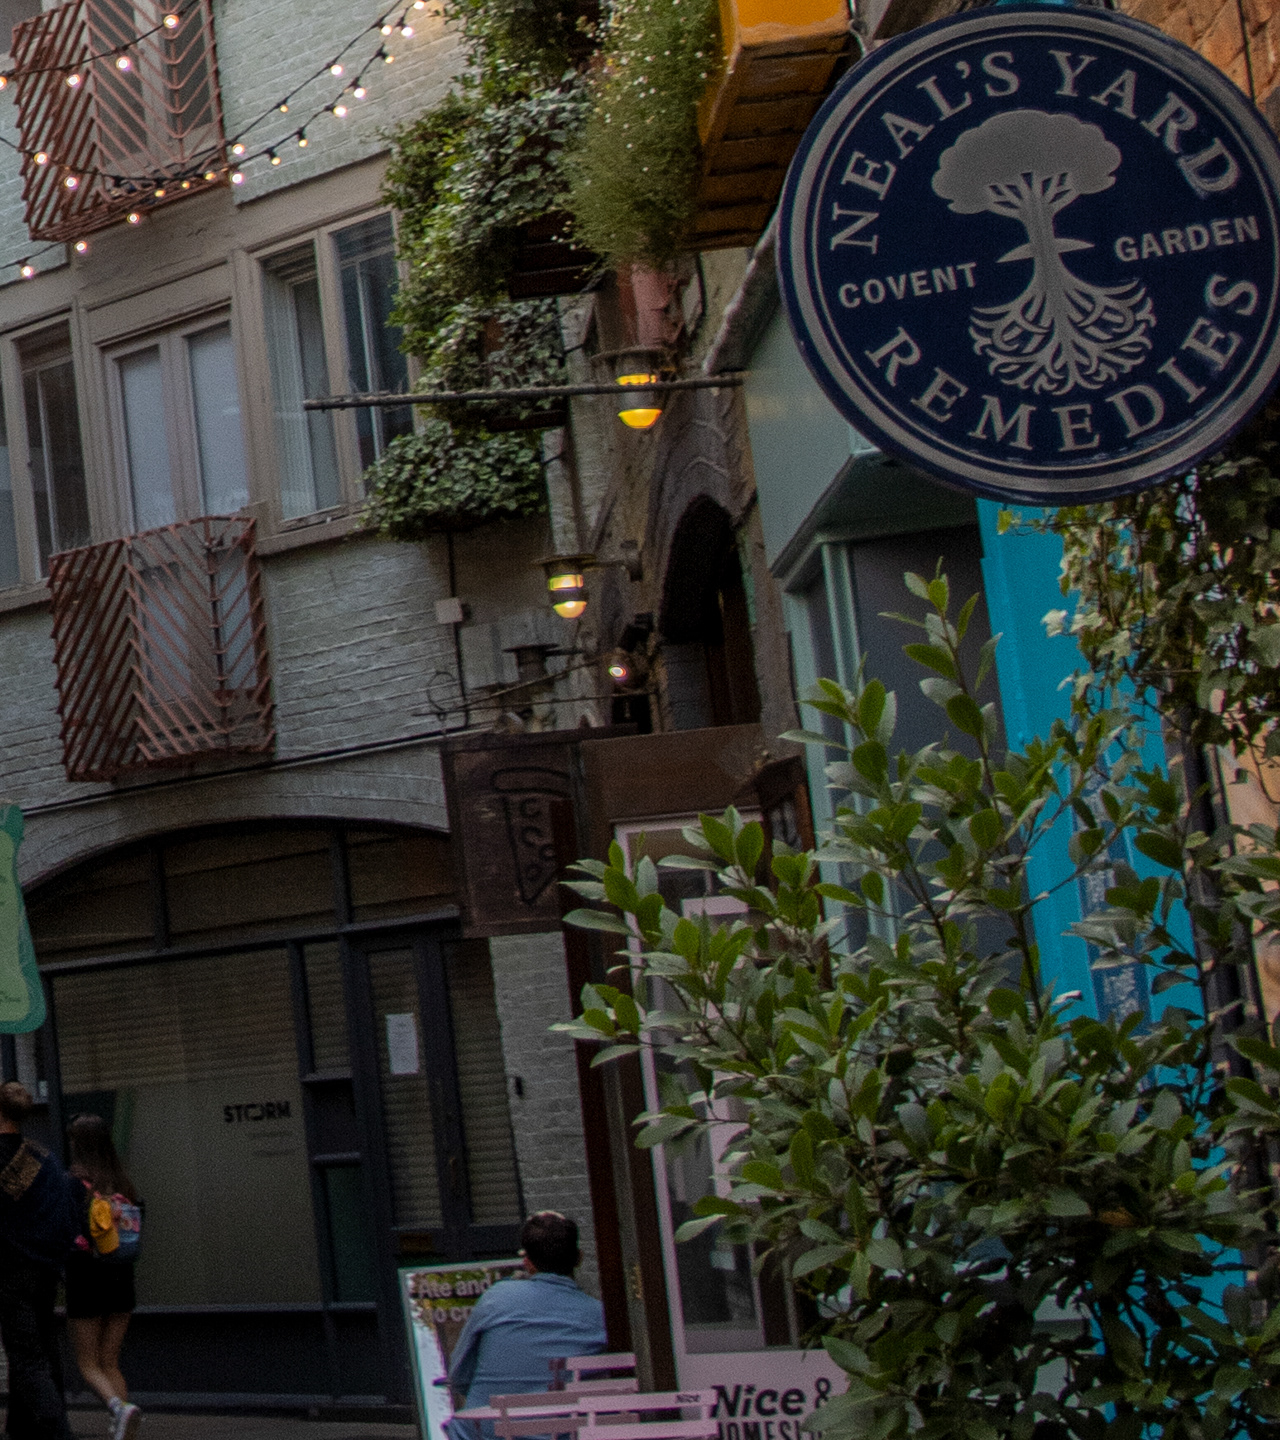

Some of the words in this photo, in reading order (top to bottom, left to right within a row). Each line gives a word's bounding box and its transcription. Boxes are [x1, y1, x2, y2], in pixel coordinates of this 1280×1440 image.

[830, 51, 1020, 254] NEAL'S
[1049, 49, 1240, 195] YARD
[839, 262, 978, 309] COVENT
[1115, 216, 1260, 263] GARDEN
[865, 274, 1259, 452] REMEDIES
[223, 1101, 292, 1123] STORM
[711, 1385, 806, 1417] Nice
